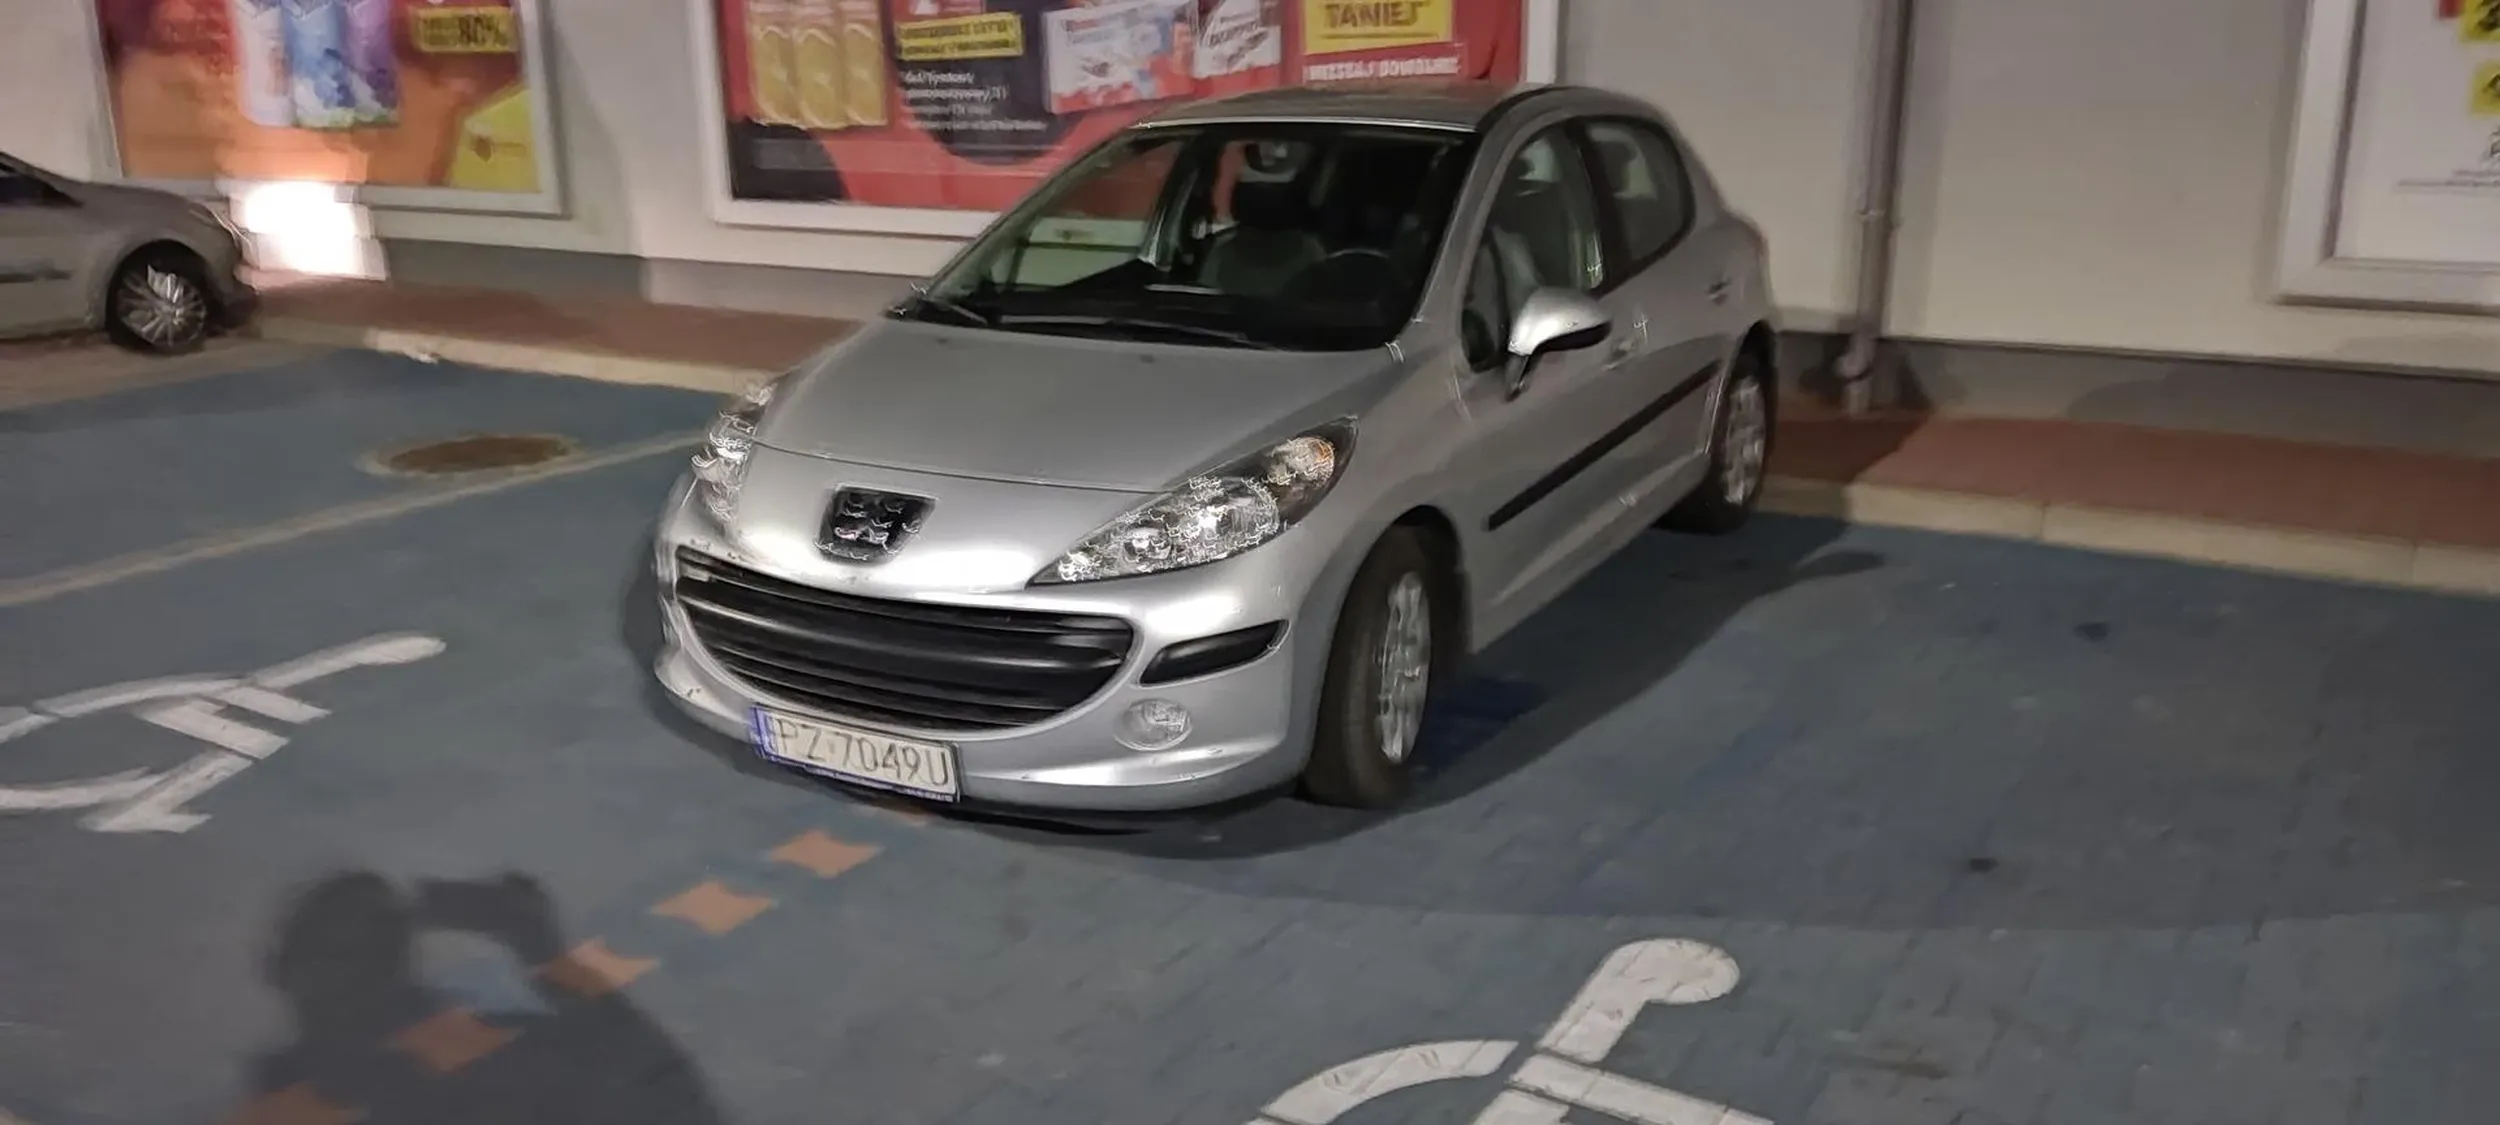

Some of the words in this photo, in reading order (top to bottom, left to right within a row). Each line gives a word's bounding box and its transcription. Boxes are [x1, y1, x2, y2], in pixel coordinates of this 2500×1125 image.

[1323, 0, 1430, 28] TANIEJ
[776, 717, 827, 761] PZ
[833, 730, 949, 787] 7049U
